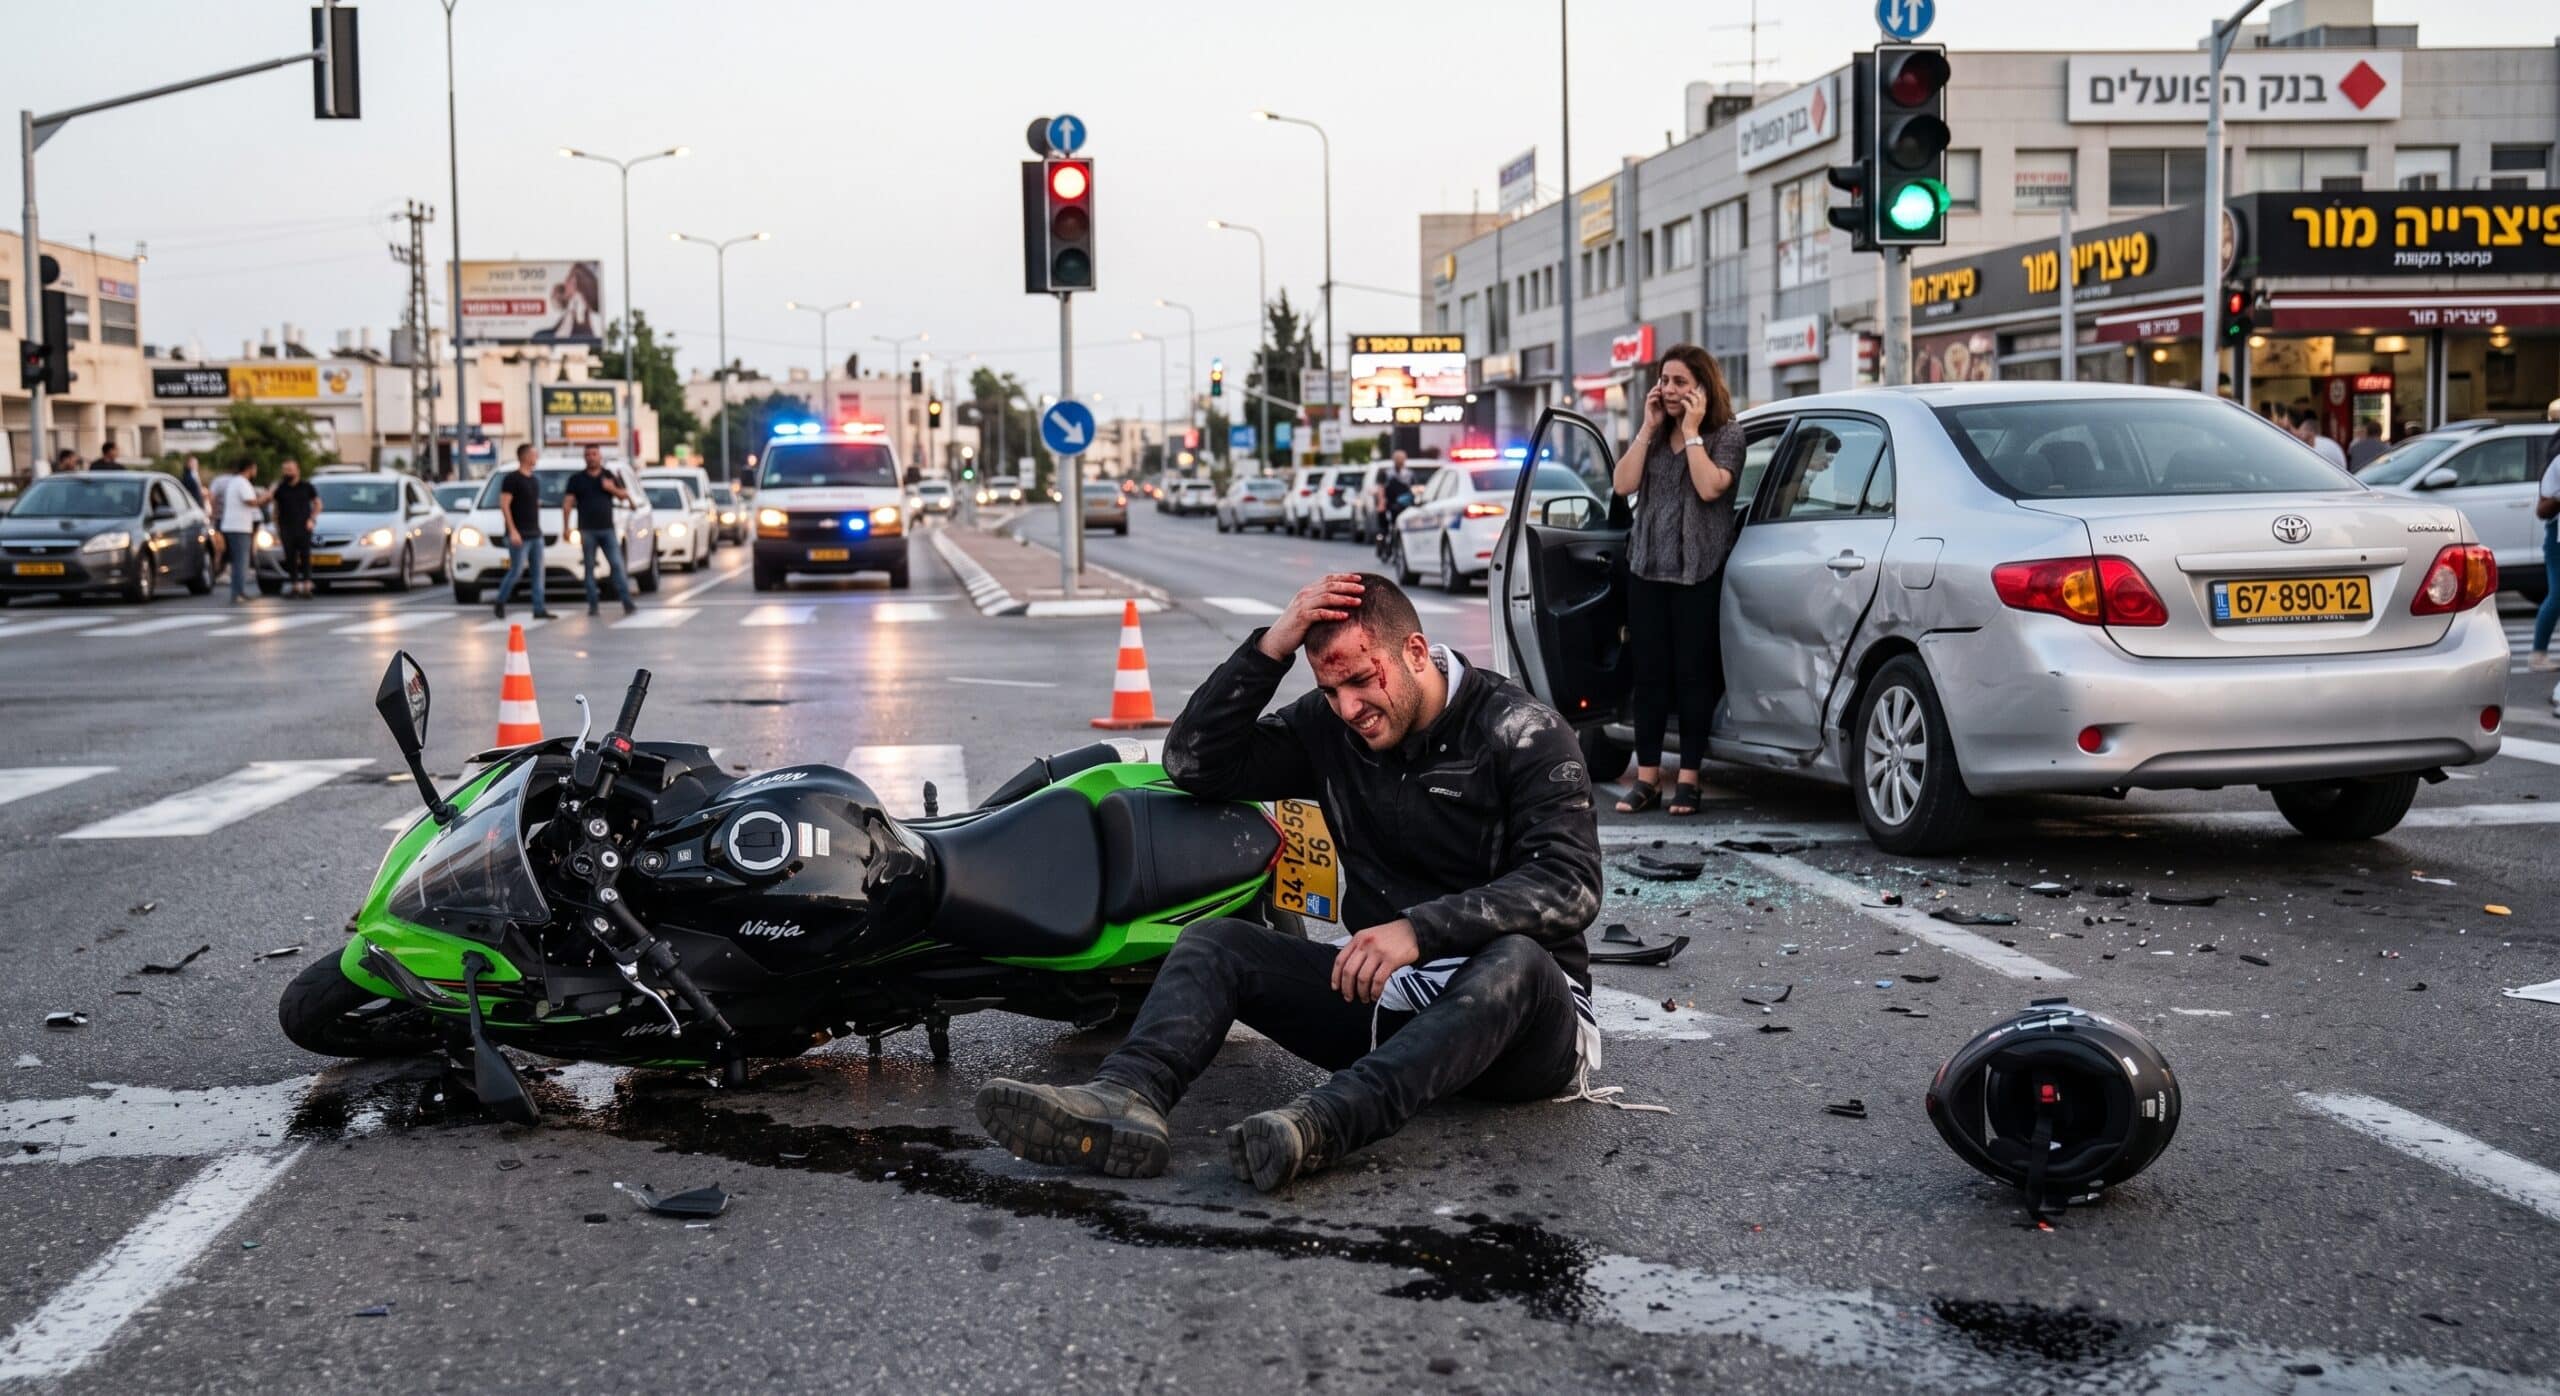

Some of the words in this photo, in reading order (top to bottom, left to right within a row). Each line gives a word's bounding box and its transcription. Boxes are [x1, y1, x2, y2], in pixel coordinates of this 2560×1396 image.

[2089, 68, 2246, 104] הפועלים
[2259, 74, 2327, 110] בנק
[2292, 206, 2378, 248] מור
[2021, 249, 2058, 294] מור
[2102, 532, 2151, 544] TOYOTA
[1308, 837, 1331, 868] 56
[738, 919, 806, 942] Ninja
